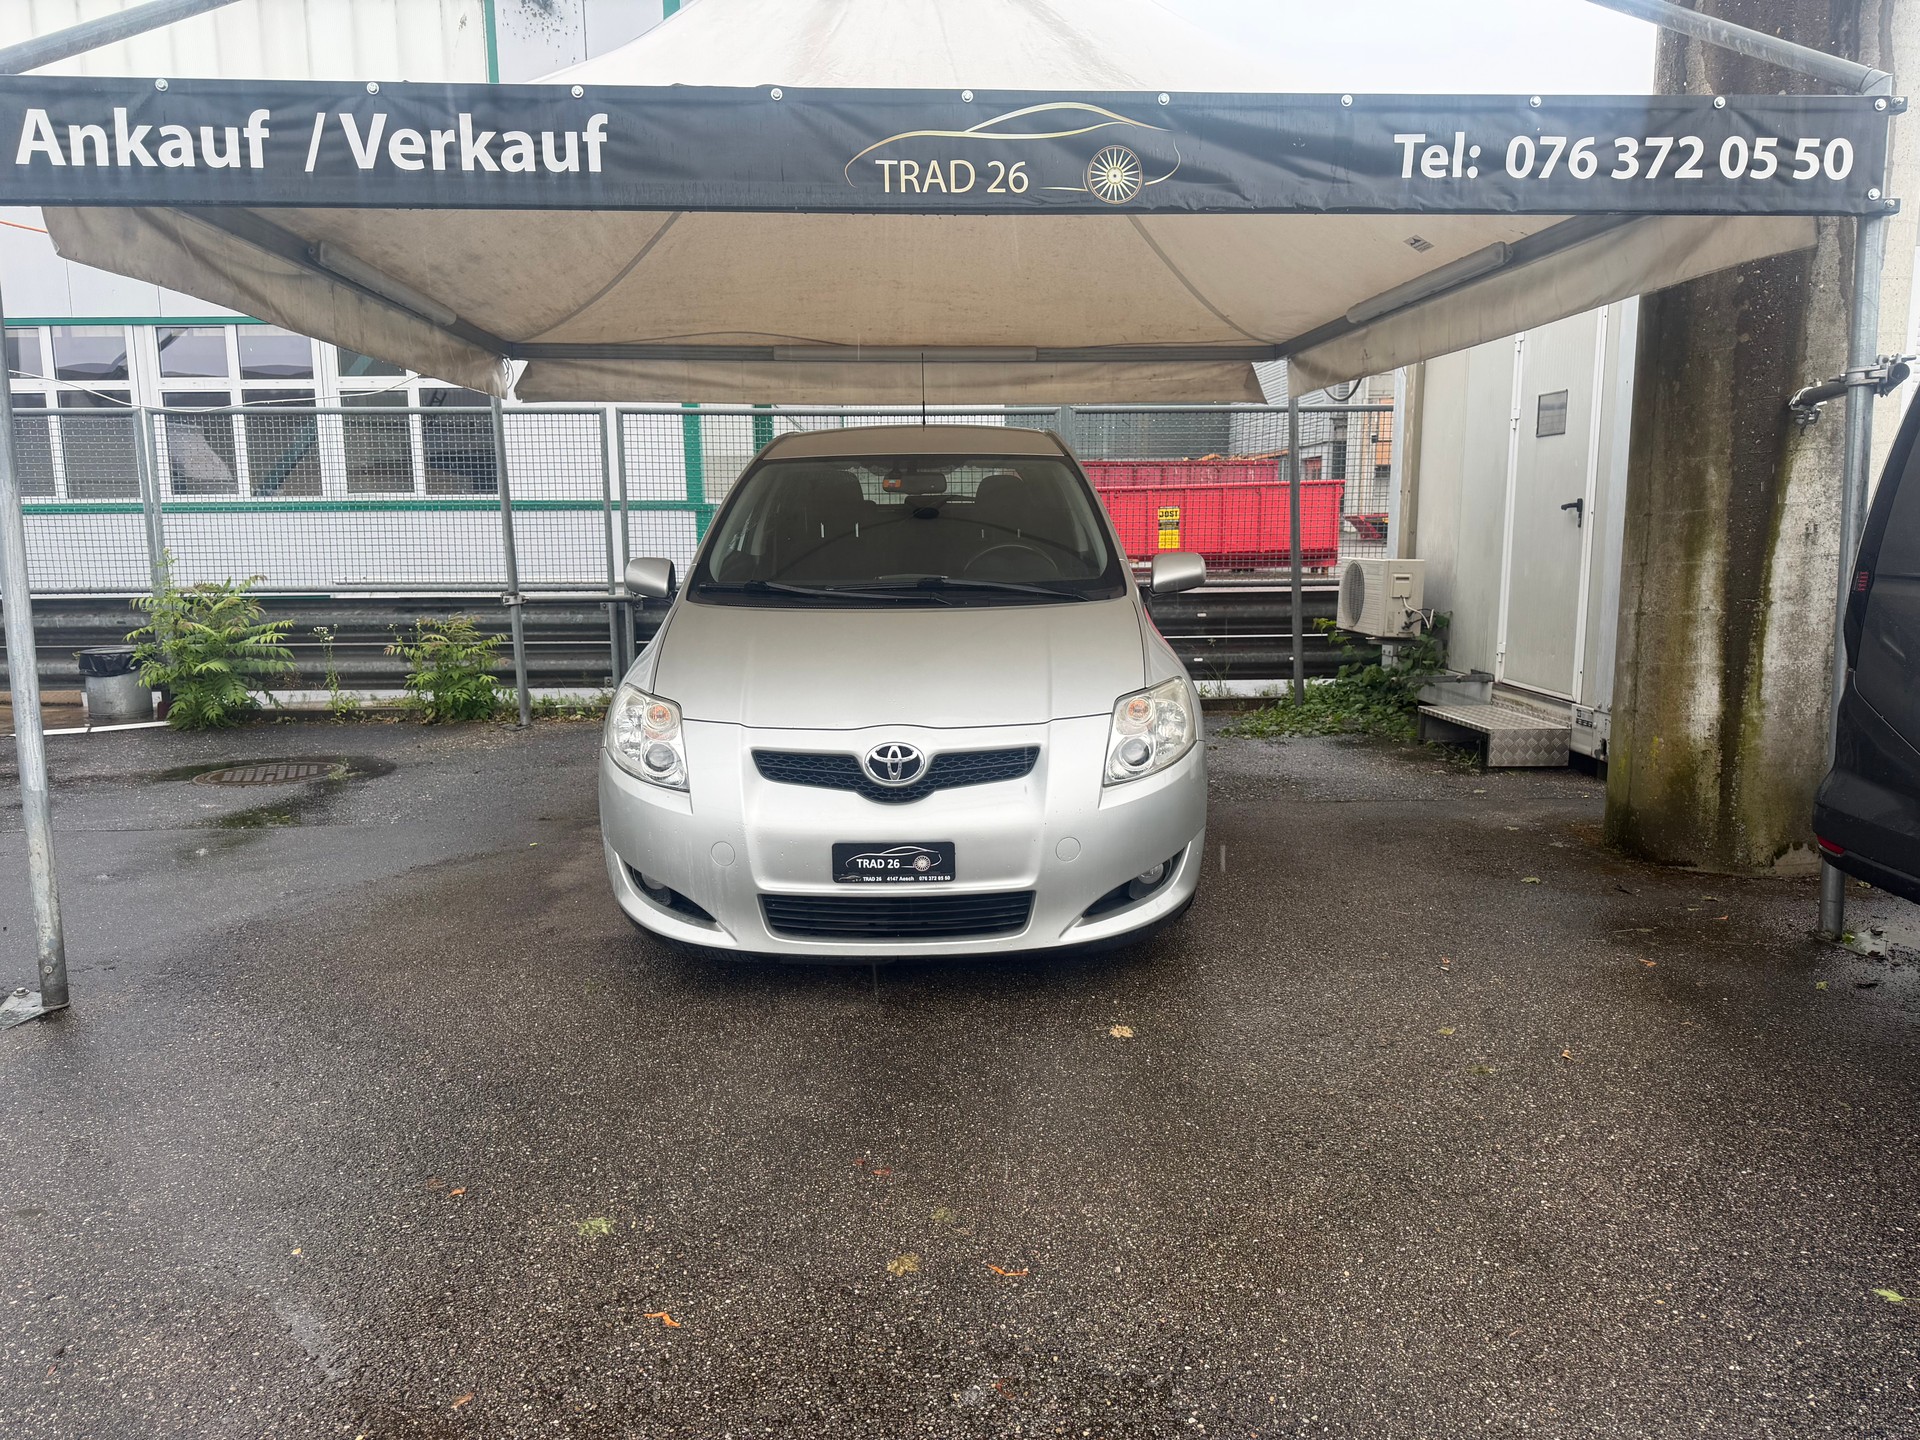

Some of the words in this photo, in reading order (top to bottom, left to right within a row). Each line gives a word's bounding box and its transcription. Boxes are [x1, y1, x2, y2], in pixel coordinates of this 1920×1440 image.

[15, 107, 270, 168] Ankauf
[1394, 131, 1482, 179] Tel:
[1505, 135, 1598, 180] 076
[1610, 135, 1705, 180] 372
[1719, 135, 1778, 180] 05
[1792, 137, 1854, 181] 50
[875, 159, 976, 194] TRAD
[986, 160, 1029, 194] 26
[1159, 510, 1178, 518] JOST
[856, 859, 885, 869] TRAD
[887, 859, 900, 869] 26
